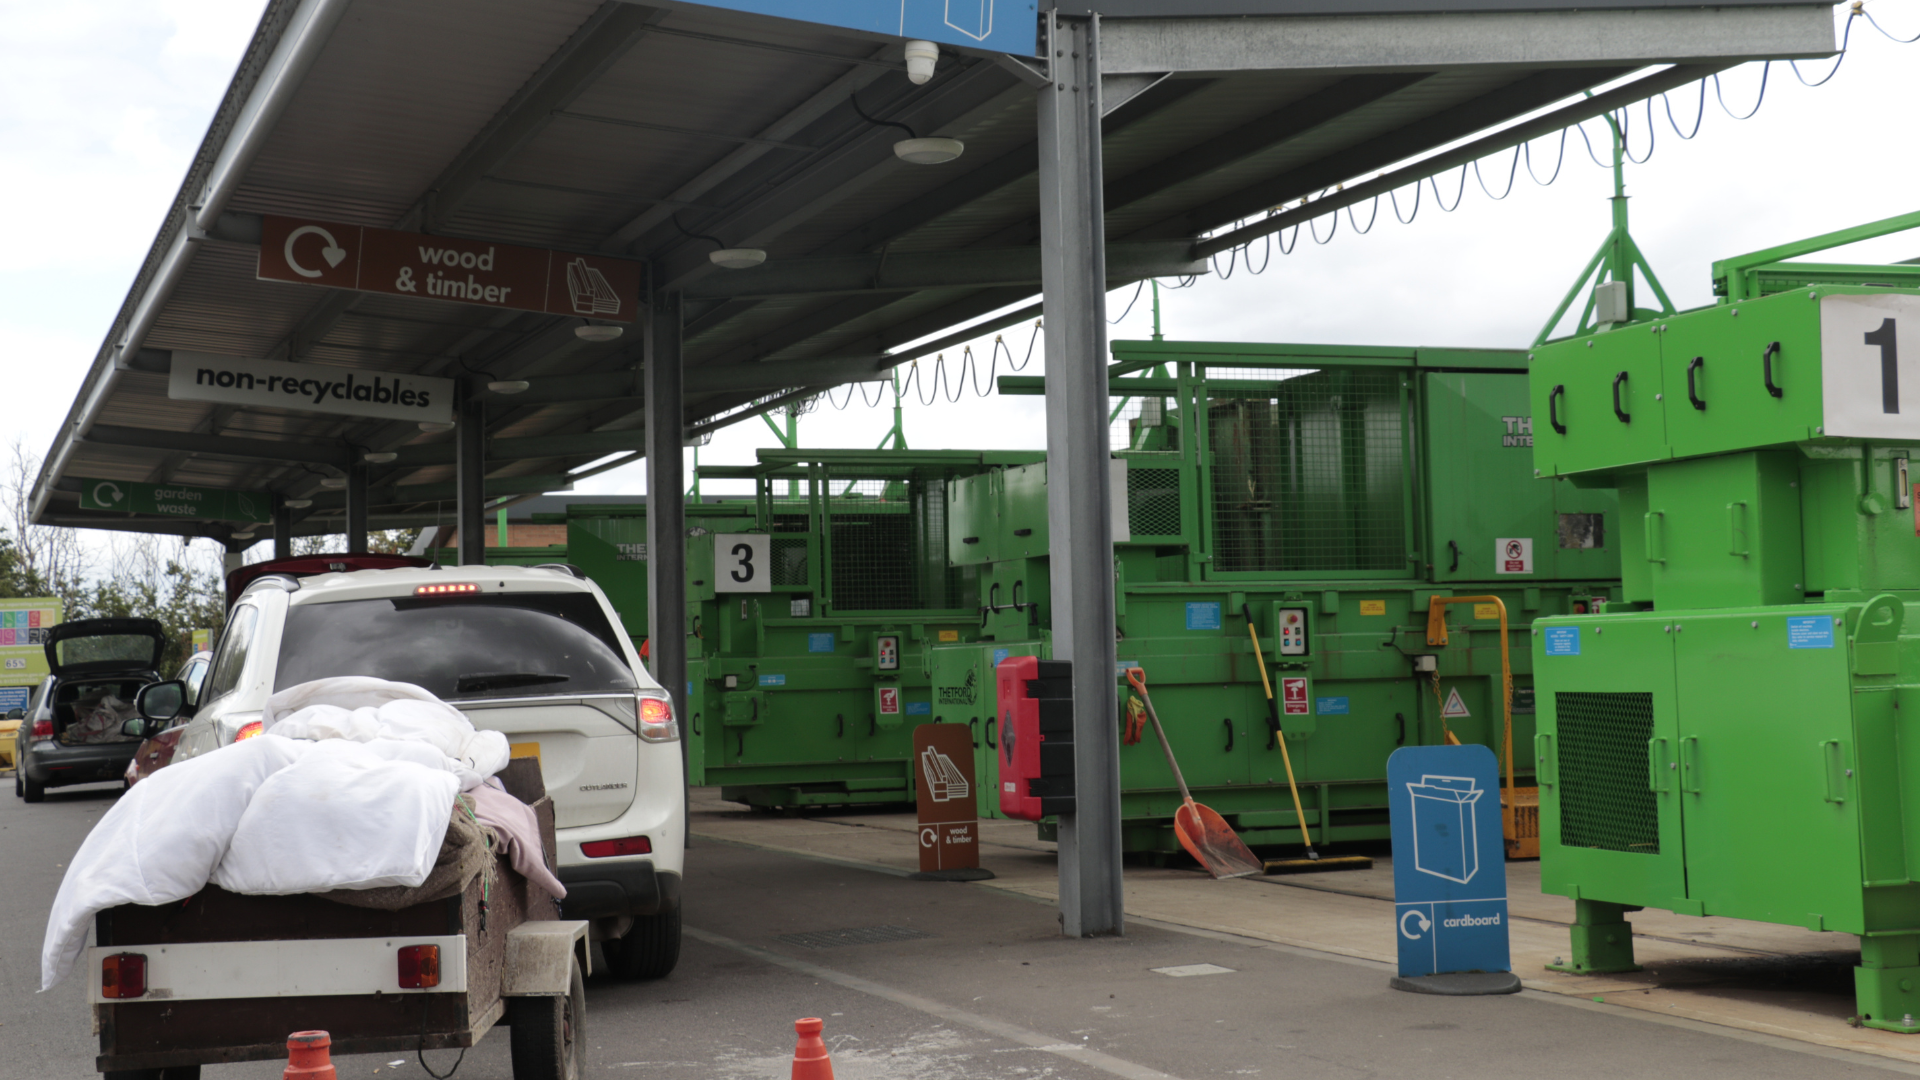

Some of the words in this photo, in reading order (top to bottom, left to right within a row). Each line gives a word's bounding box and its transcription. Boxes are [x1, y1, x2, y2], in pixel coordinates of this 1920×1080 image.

[418, 246, 495, 271] wood
[395, 266, 417, 293] &
[426, 270, 512, 303] timber
[1864, 317, 1900, 414] 1
[196, 367, 430, 408] non-recyclables
[154, 487, 202, 501] garden
[156, 503, 197, 515] waste
[731, 543, 755, 583] 3
[5, 659, 25, 668] 65%
[938, 686, 972, 698] THETFORD
[949, 825, 968, 835] wood
[945, 835, 952, 844] &
[952, 834, 972, 844] timber
[1443, 912, 1501, 928] cardboard
